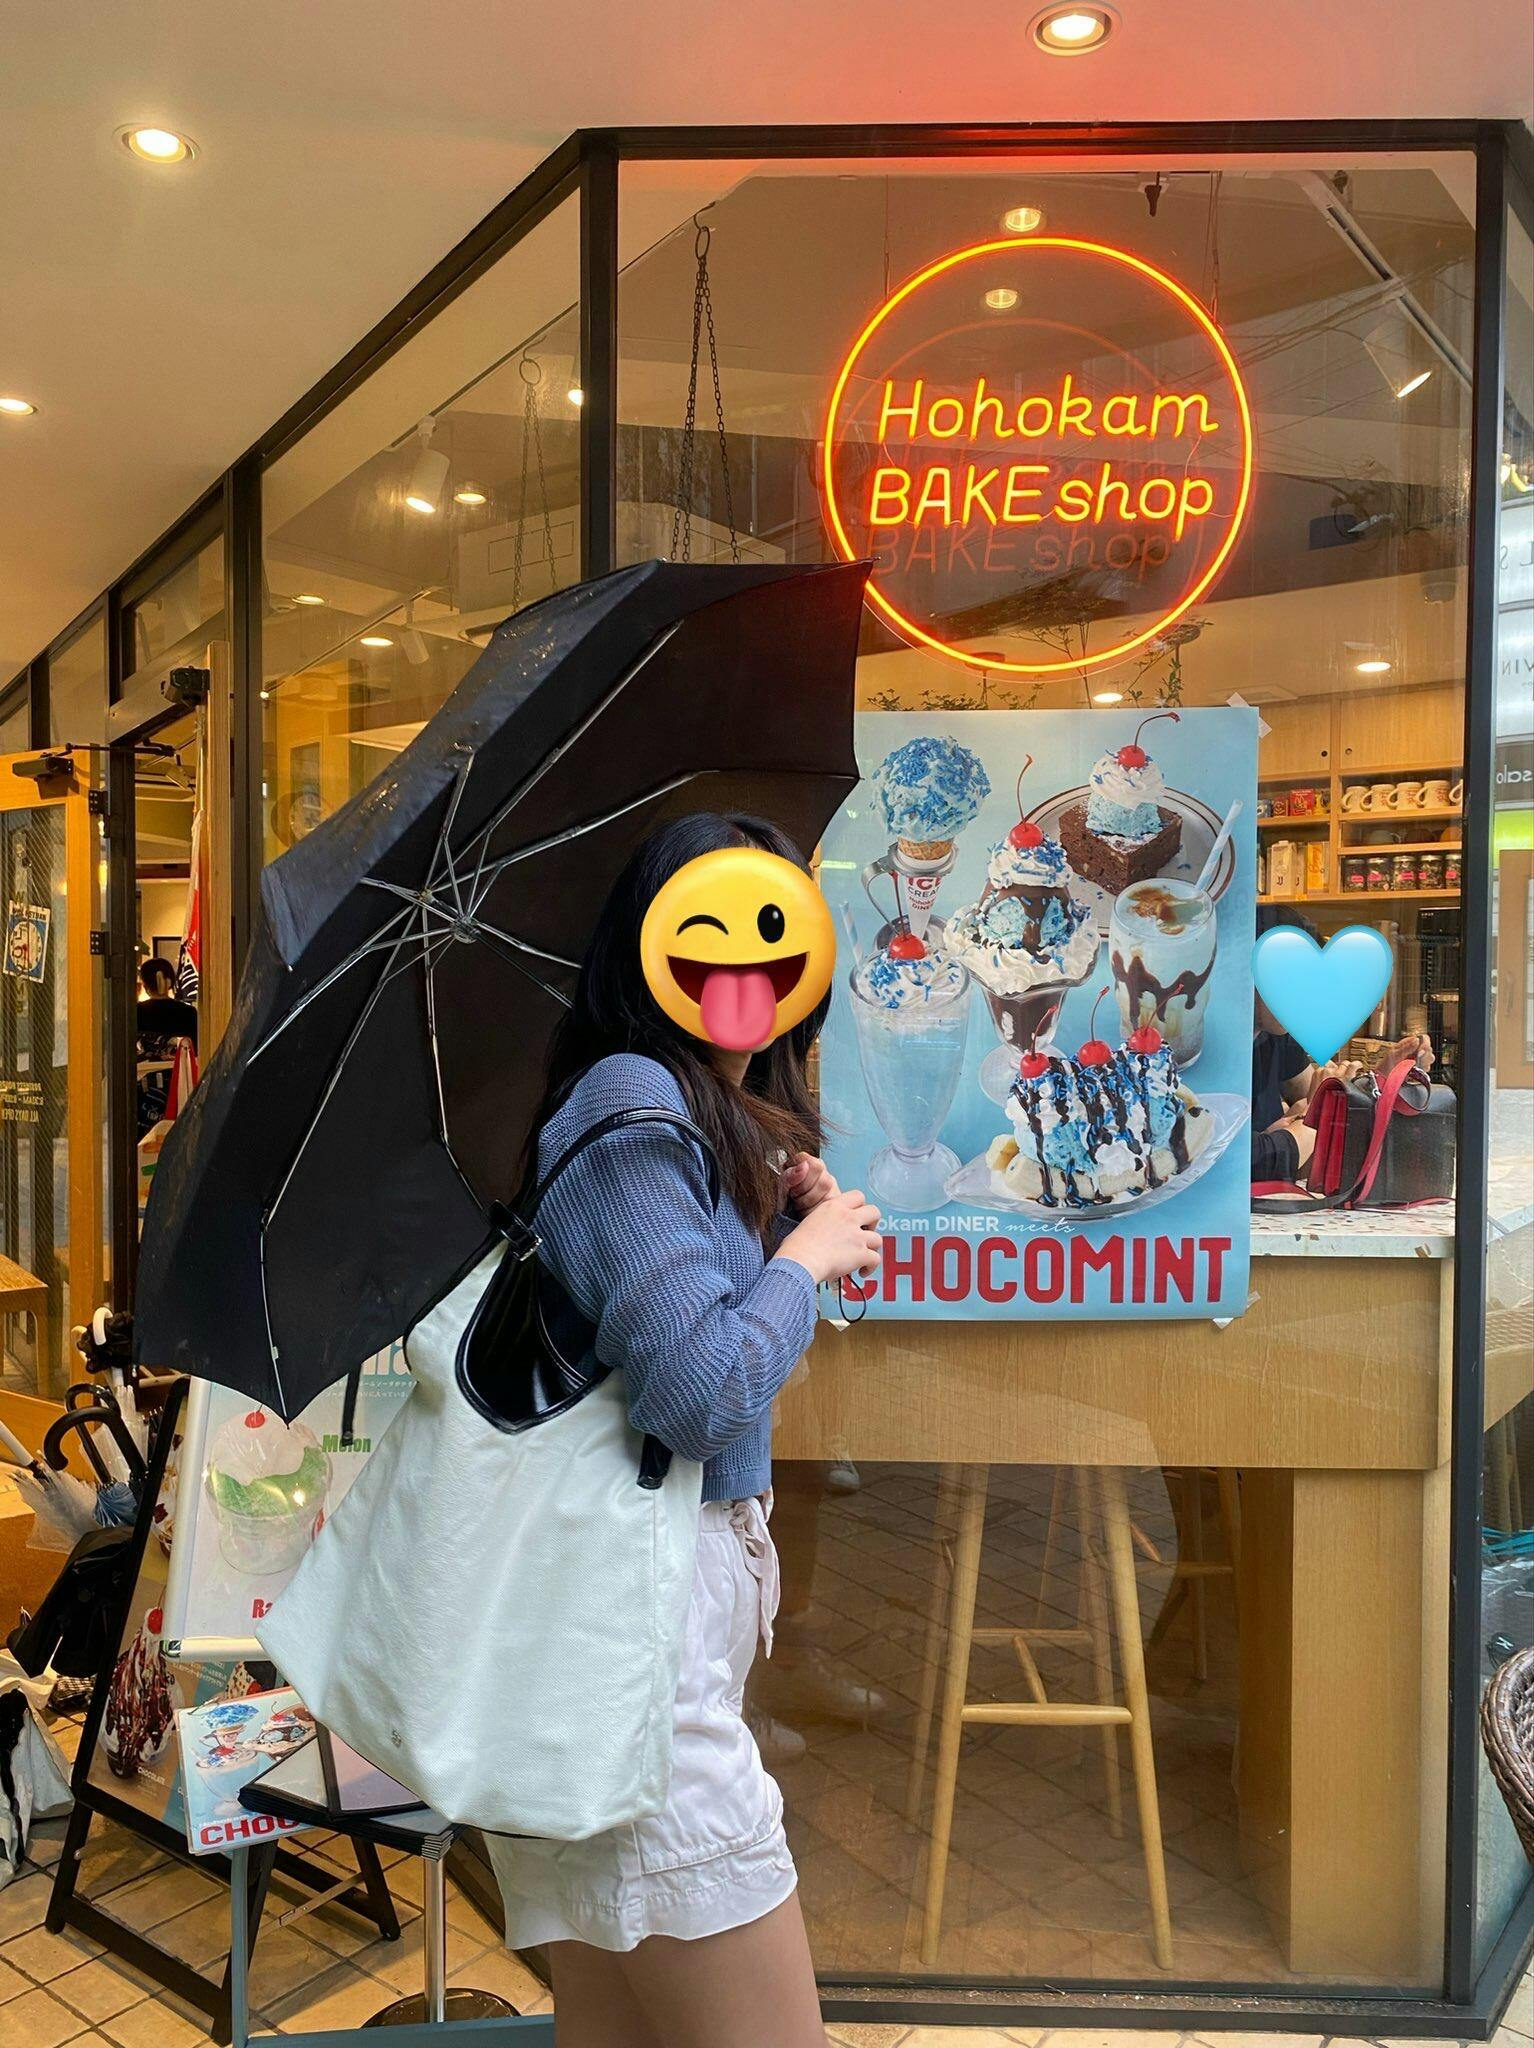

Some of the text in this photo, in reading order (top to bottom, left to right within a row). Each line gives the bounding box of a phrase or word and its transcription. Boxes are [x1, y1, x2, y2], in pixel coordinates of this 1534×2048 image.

[878, 374, 1220, 444] Hohokam
[868, 462, 1214, 542] BAKE shop
[907, 886, 940, 898] CREA
[935, 1216, 999, 1232] DINER
[1004, 1217, 1075, 1234] meets
